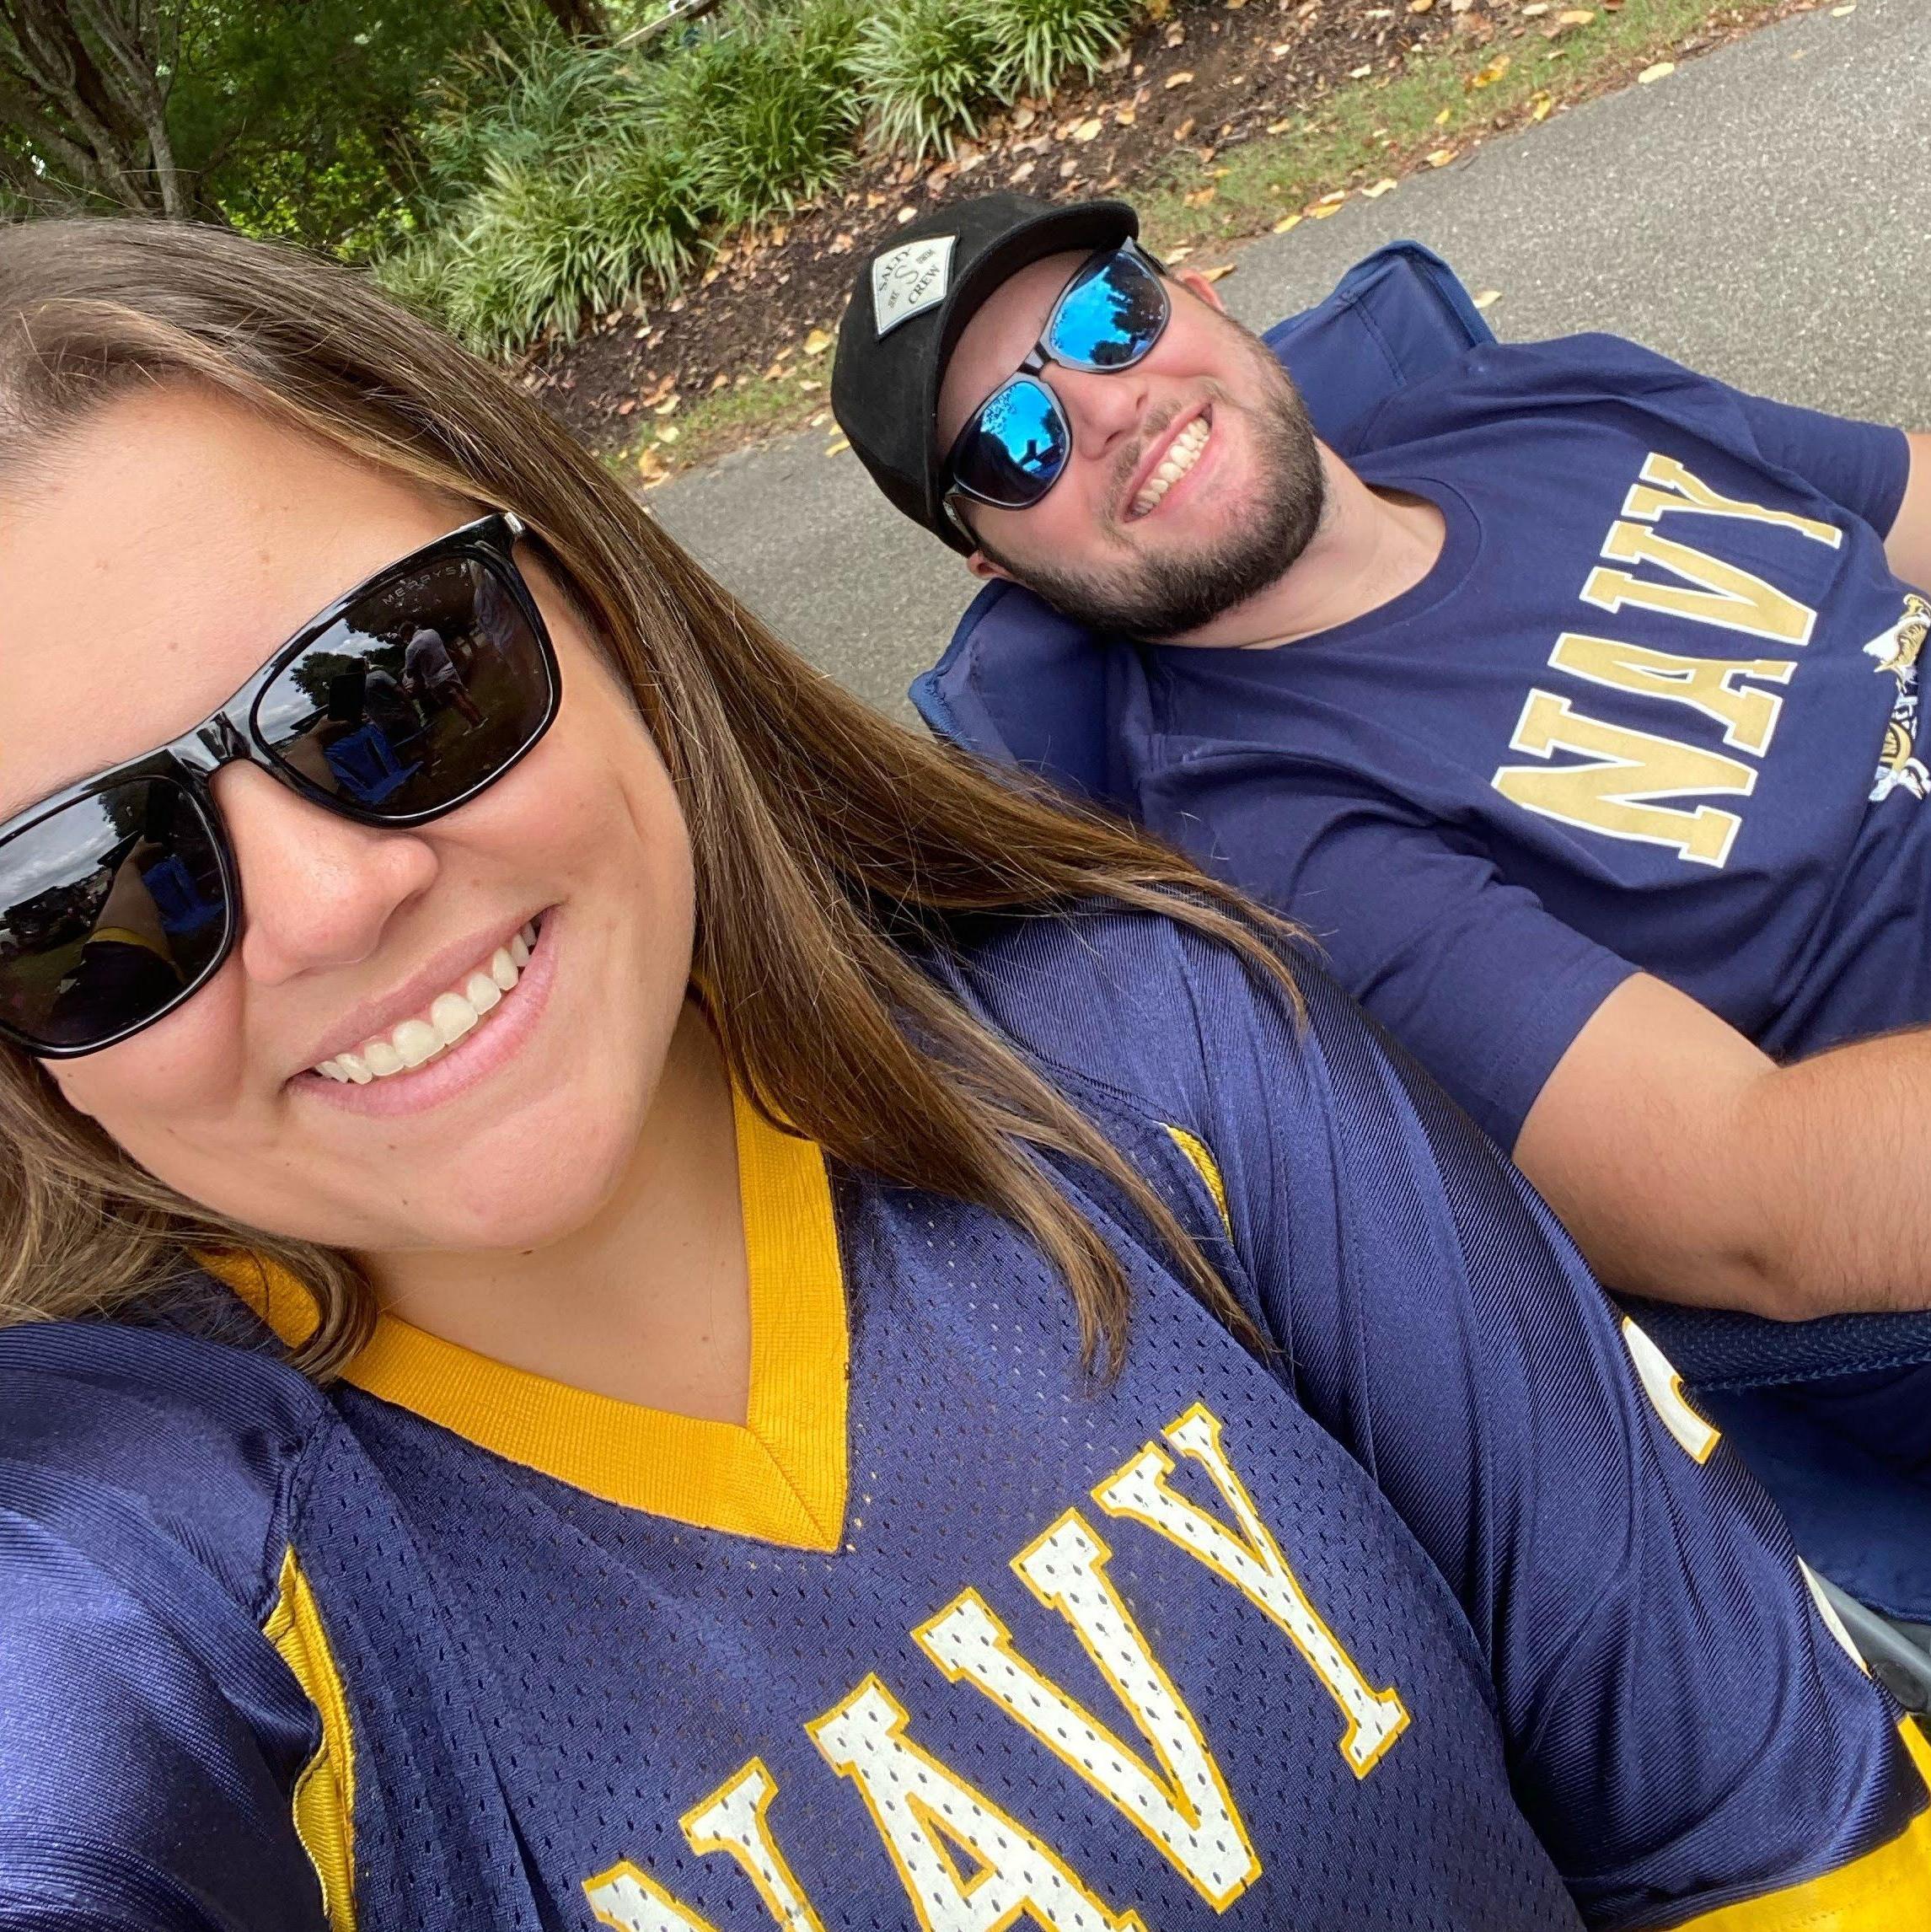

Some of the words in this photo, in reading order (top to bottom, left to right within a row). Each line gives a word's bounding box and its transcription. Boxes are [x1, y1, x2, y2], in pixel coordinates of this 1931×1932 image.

[879, 248, 911, 292] SALTY
[894, 266, 919, 284] S
[908, 265, 940, 304] CREW
[1490, 452, 1842, 868] NAVY
